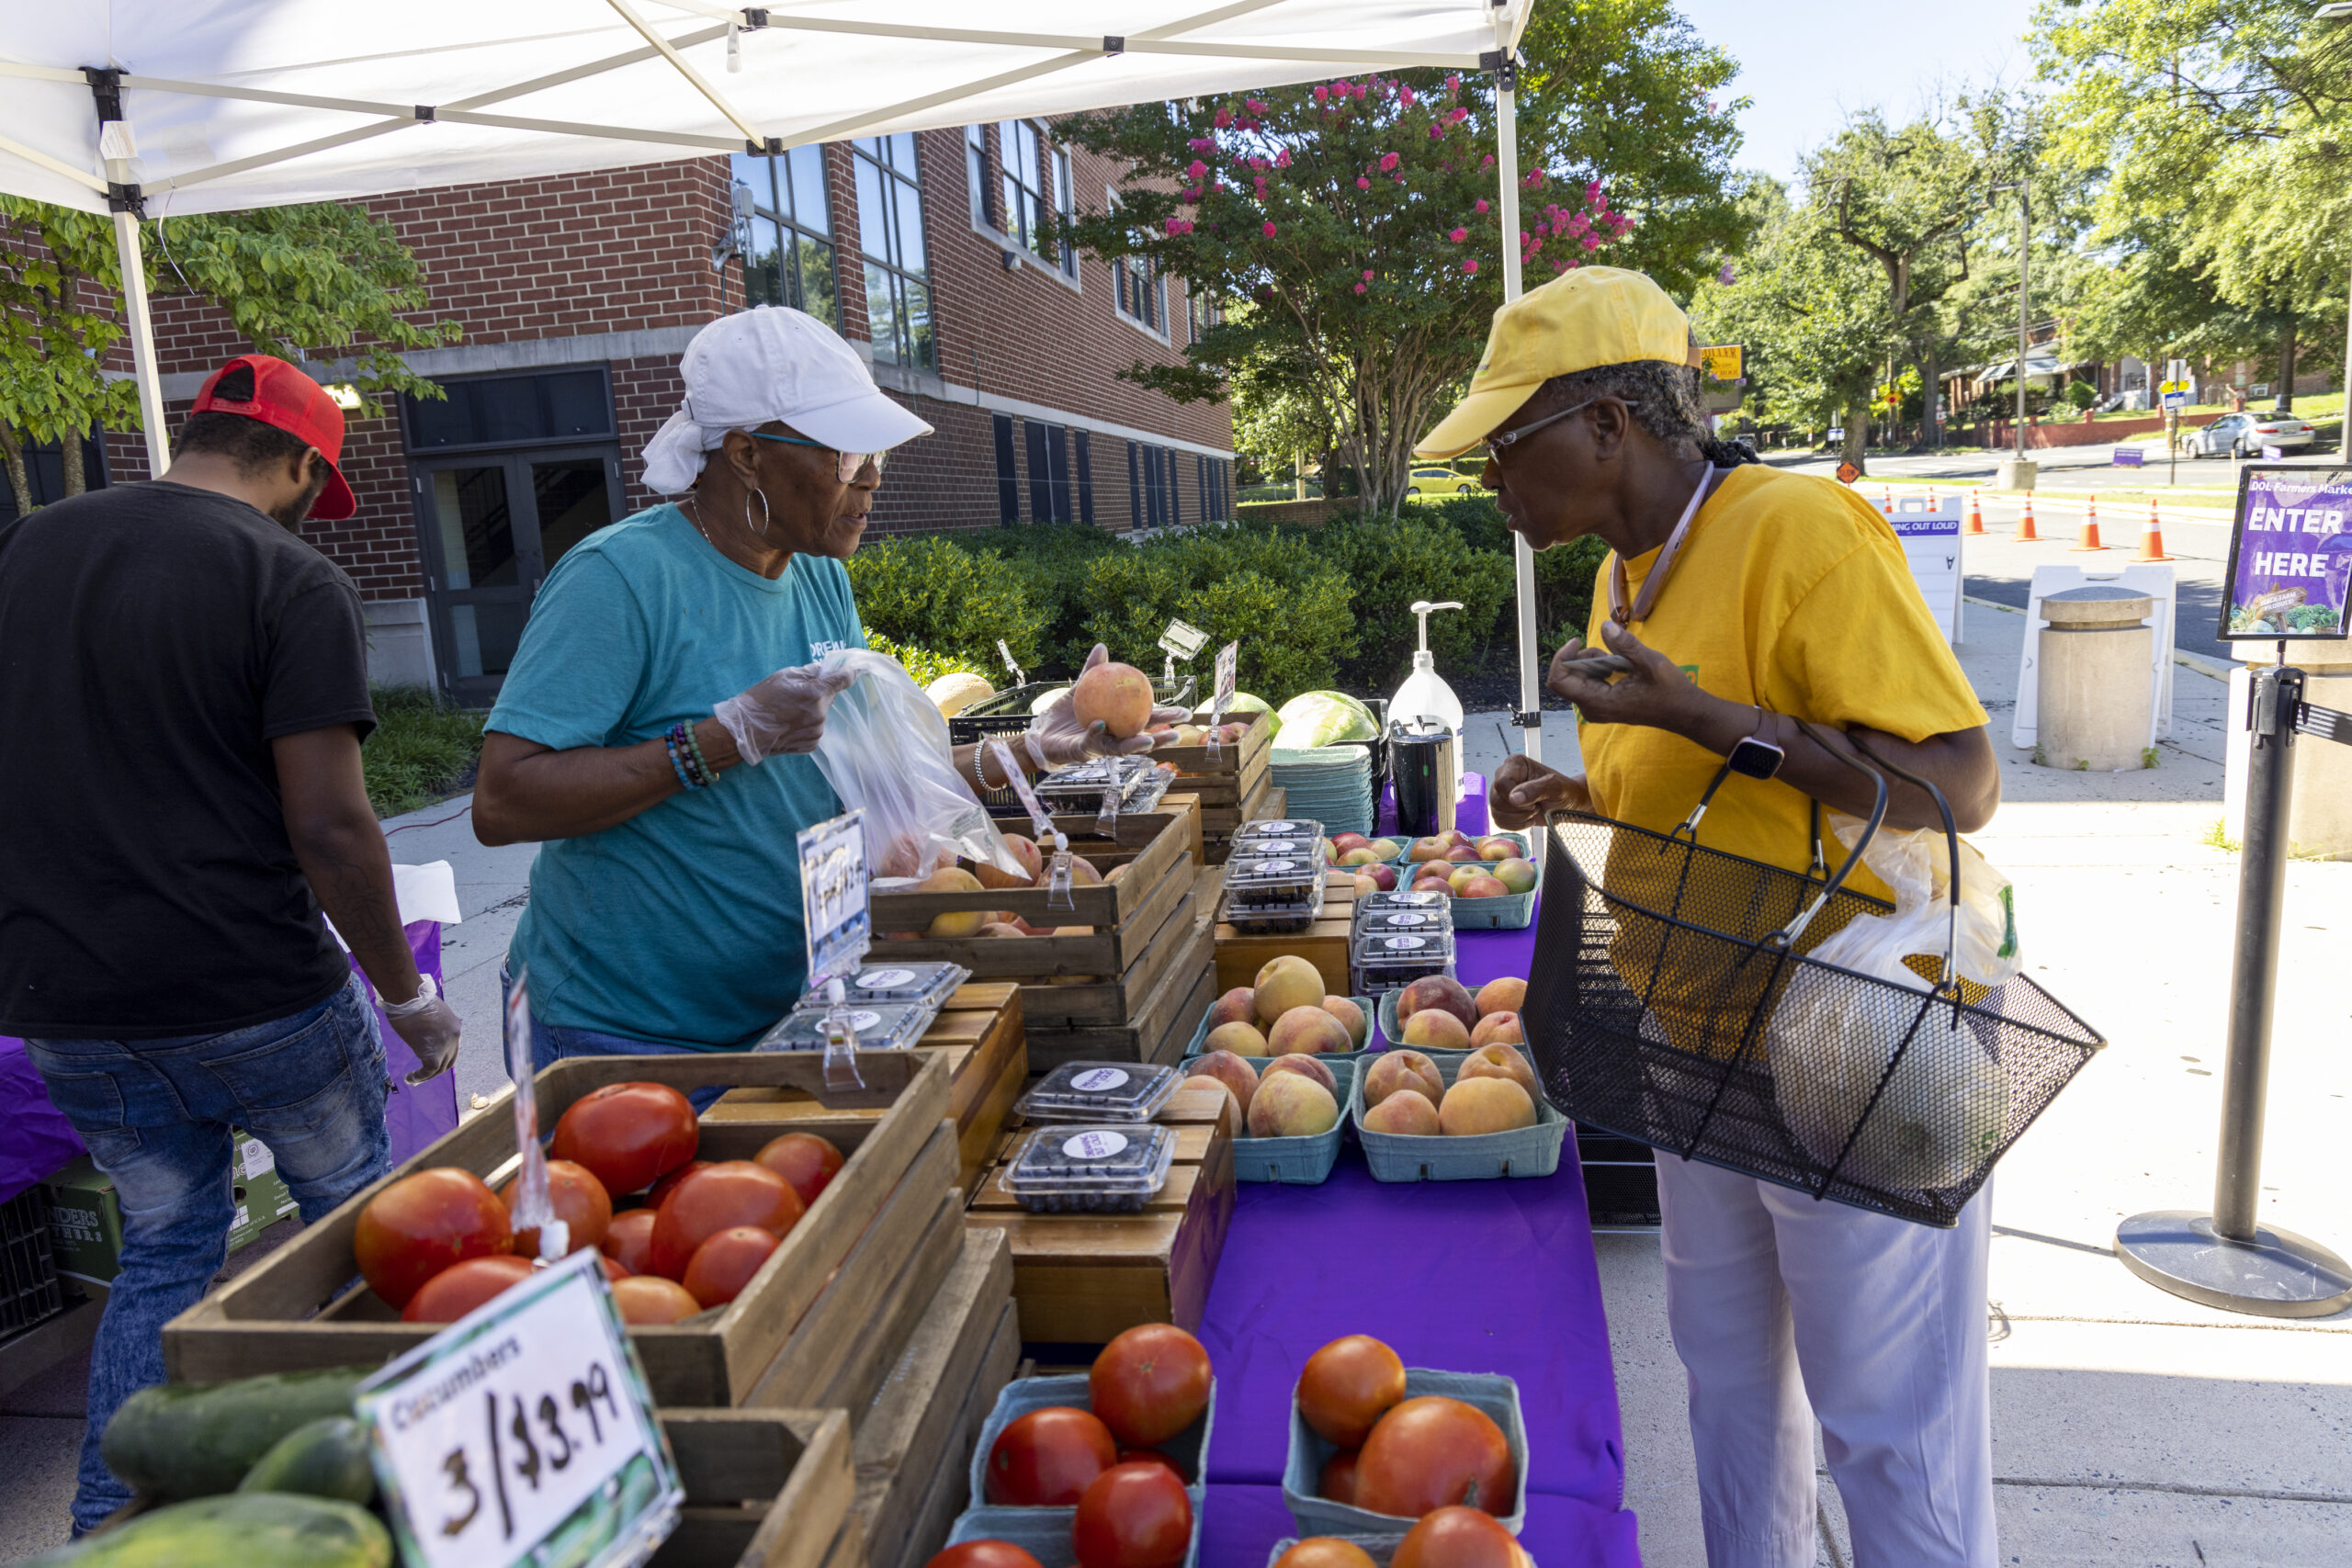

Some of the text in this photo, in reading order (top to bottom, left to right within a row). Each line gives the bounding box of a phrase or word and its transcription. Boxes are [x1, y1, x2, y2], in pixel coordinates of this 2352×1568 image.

[2251, 481, 2271, 491] DOL
[2273, 482, 2317, 493] Farmers
[1912, 522, 1931, 530] OUT
[1932, 522, 1958, 530] LOUD
[2248, 507, 2343, 534] ENTER
[2255, 552, 2330, 578] HERE
[45, 1207, 98, 1227] NDERS
[51, 1226, 103, 1243] THERS
[390, 1335, 522, 1430] Cucumbers
